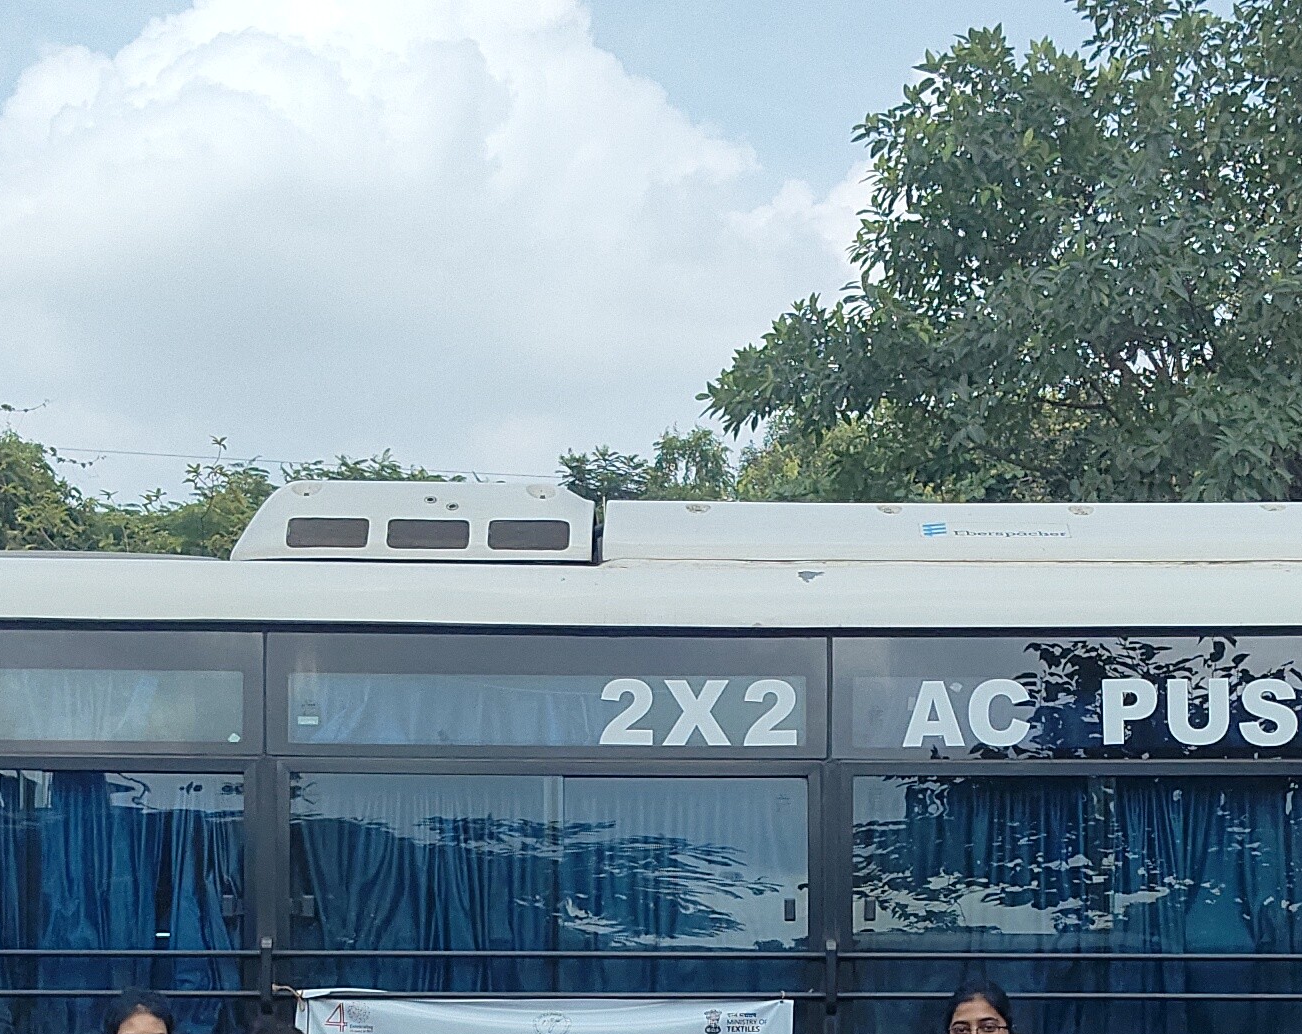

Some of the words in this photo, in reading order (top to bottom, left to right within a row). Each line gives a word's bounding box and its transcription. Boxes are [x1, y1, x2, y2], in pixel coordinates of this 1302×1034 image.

[599, 678, 797, 746] 2X2
[902, 678, 1031, 747] AC
[726, 1018, 757, 1026] MINISTRY
[726, 1025, 760, 1033] TEXTILES
